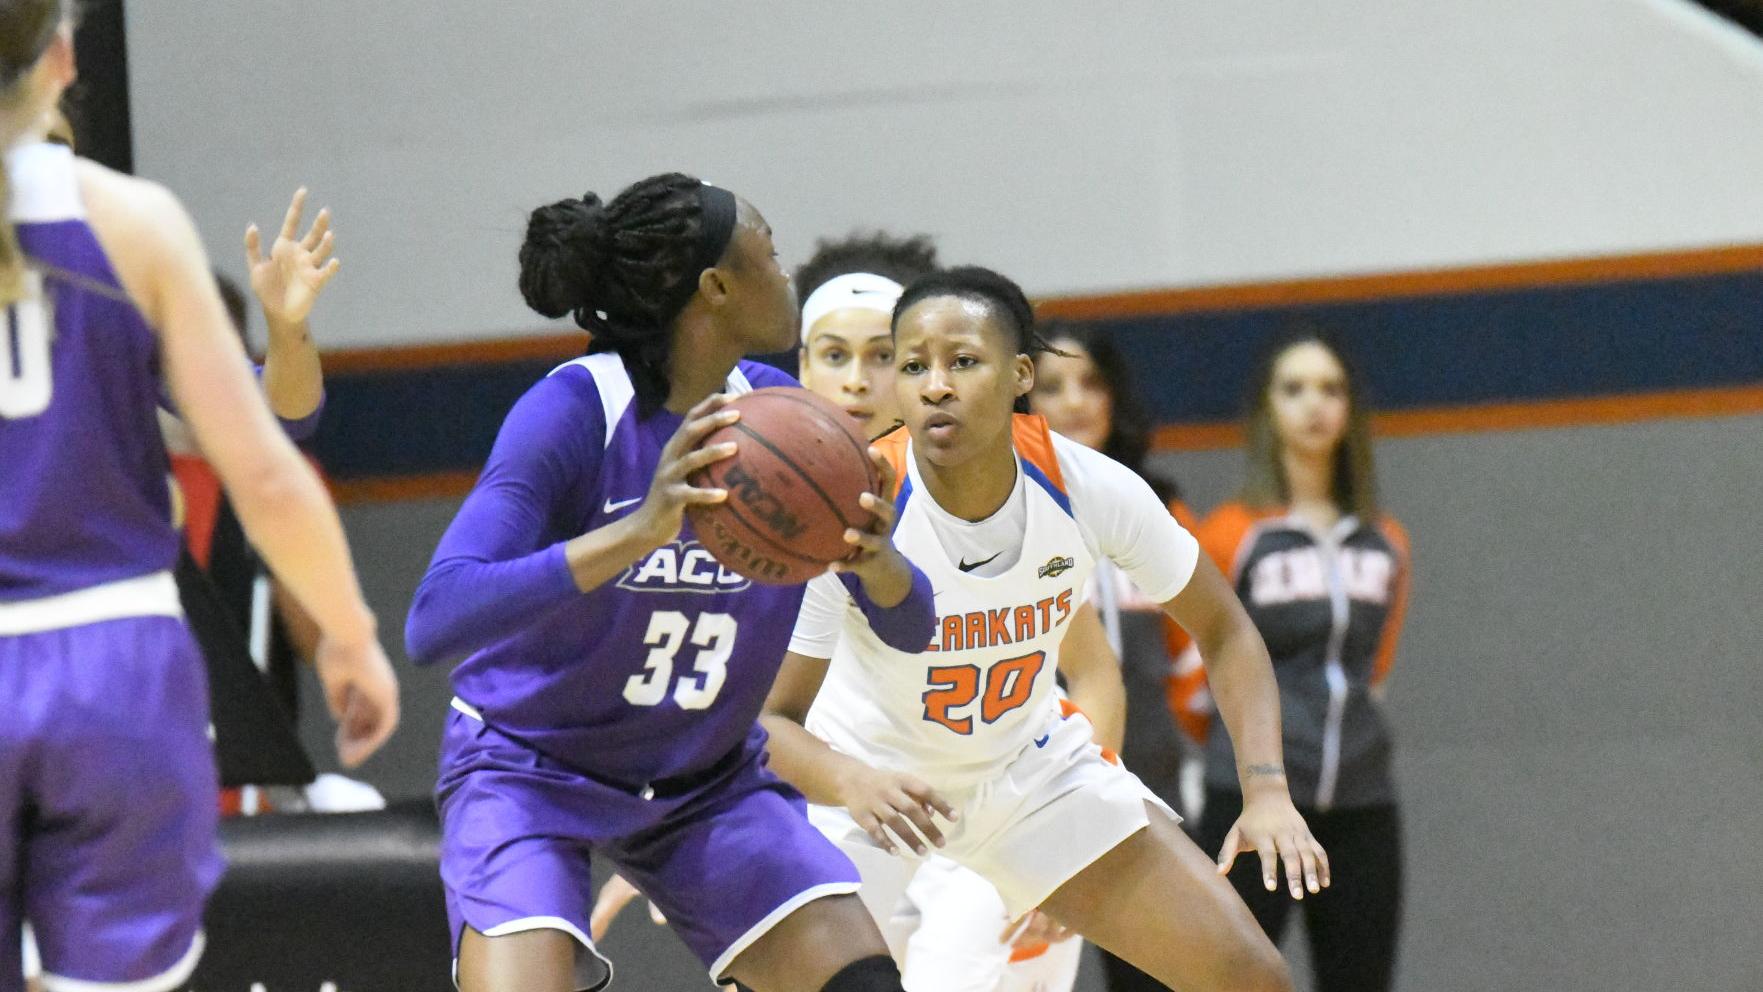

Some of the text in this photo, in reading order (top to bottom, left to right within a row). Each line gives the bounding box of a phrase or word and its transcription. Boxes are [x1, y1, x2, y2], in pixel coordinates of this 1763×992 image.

[622, 610, 738, 710] 33
[921, 588, 1073, 652] ARKATS
[921, 650, 1046, 735] 20
